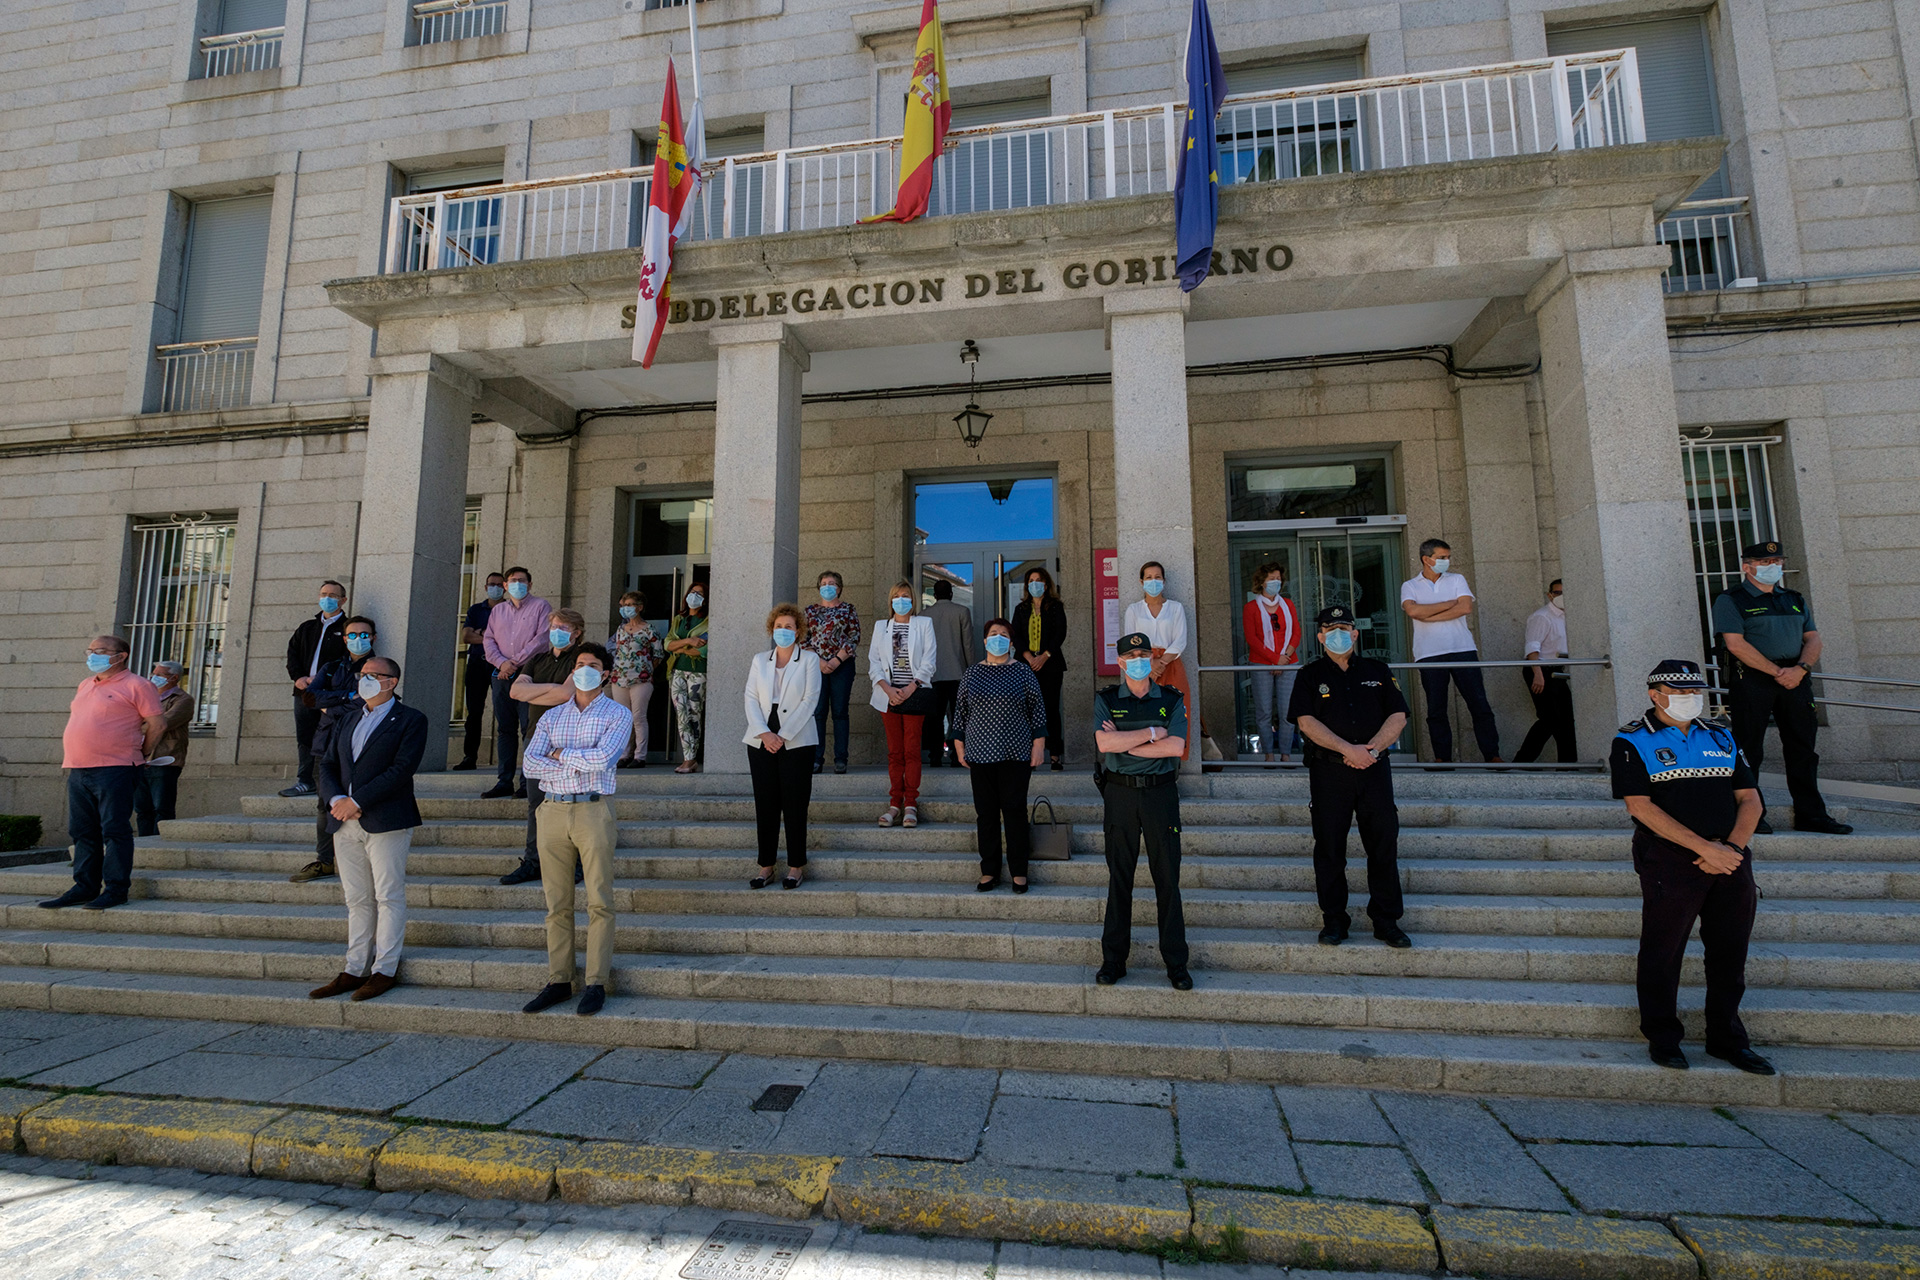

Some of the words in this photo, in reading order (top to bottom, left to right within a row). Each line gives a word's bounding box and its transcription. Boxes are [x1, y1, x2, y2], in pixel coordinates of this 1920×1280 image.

[621, 278, 945, 328] SBDELEGACION
[964, 268, 1043, 298] DEL
[1062, 245, 1294, 288] GOBIRNO
